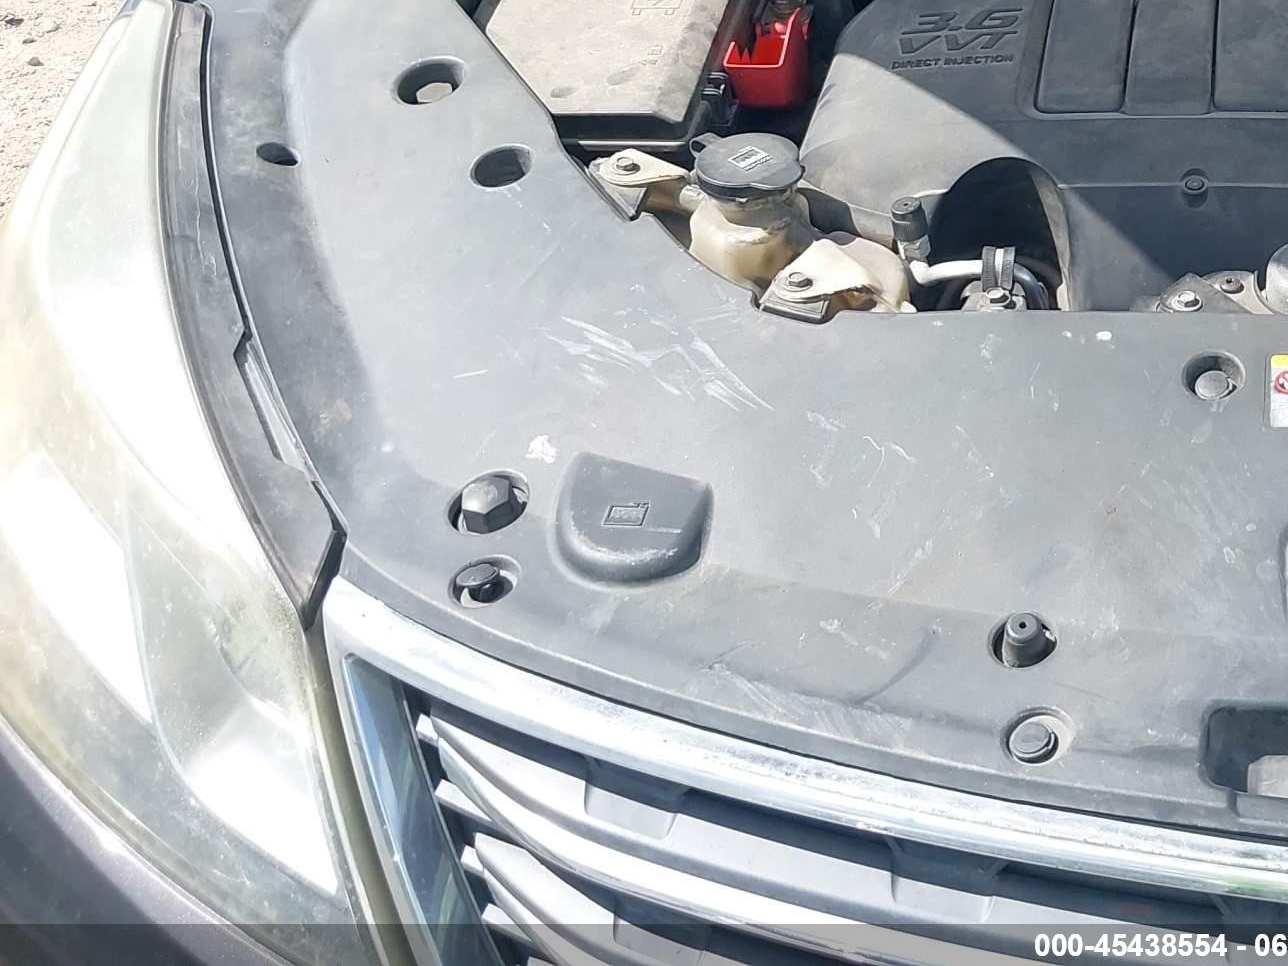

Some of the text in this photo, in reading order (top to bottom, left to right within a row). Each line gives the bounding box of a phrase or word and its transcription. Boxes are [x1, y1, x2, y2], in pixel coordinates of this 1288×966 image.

[901, 8, 1023, 35] 3.6
[899, 30, 1019, 55] VVT
[891, 54, 1014, 71] DIRECT INJECTION
